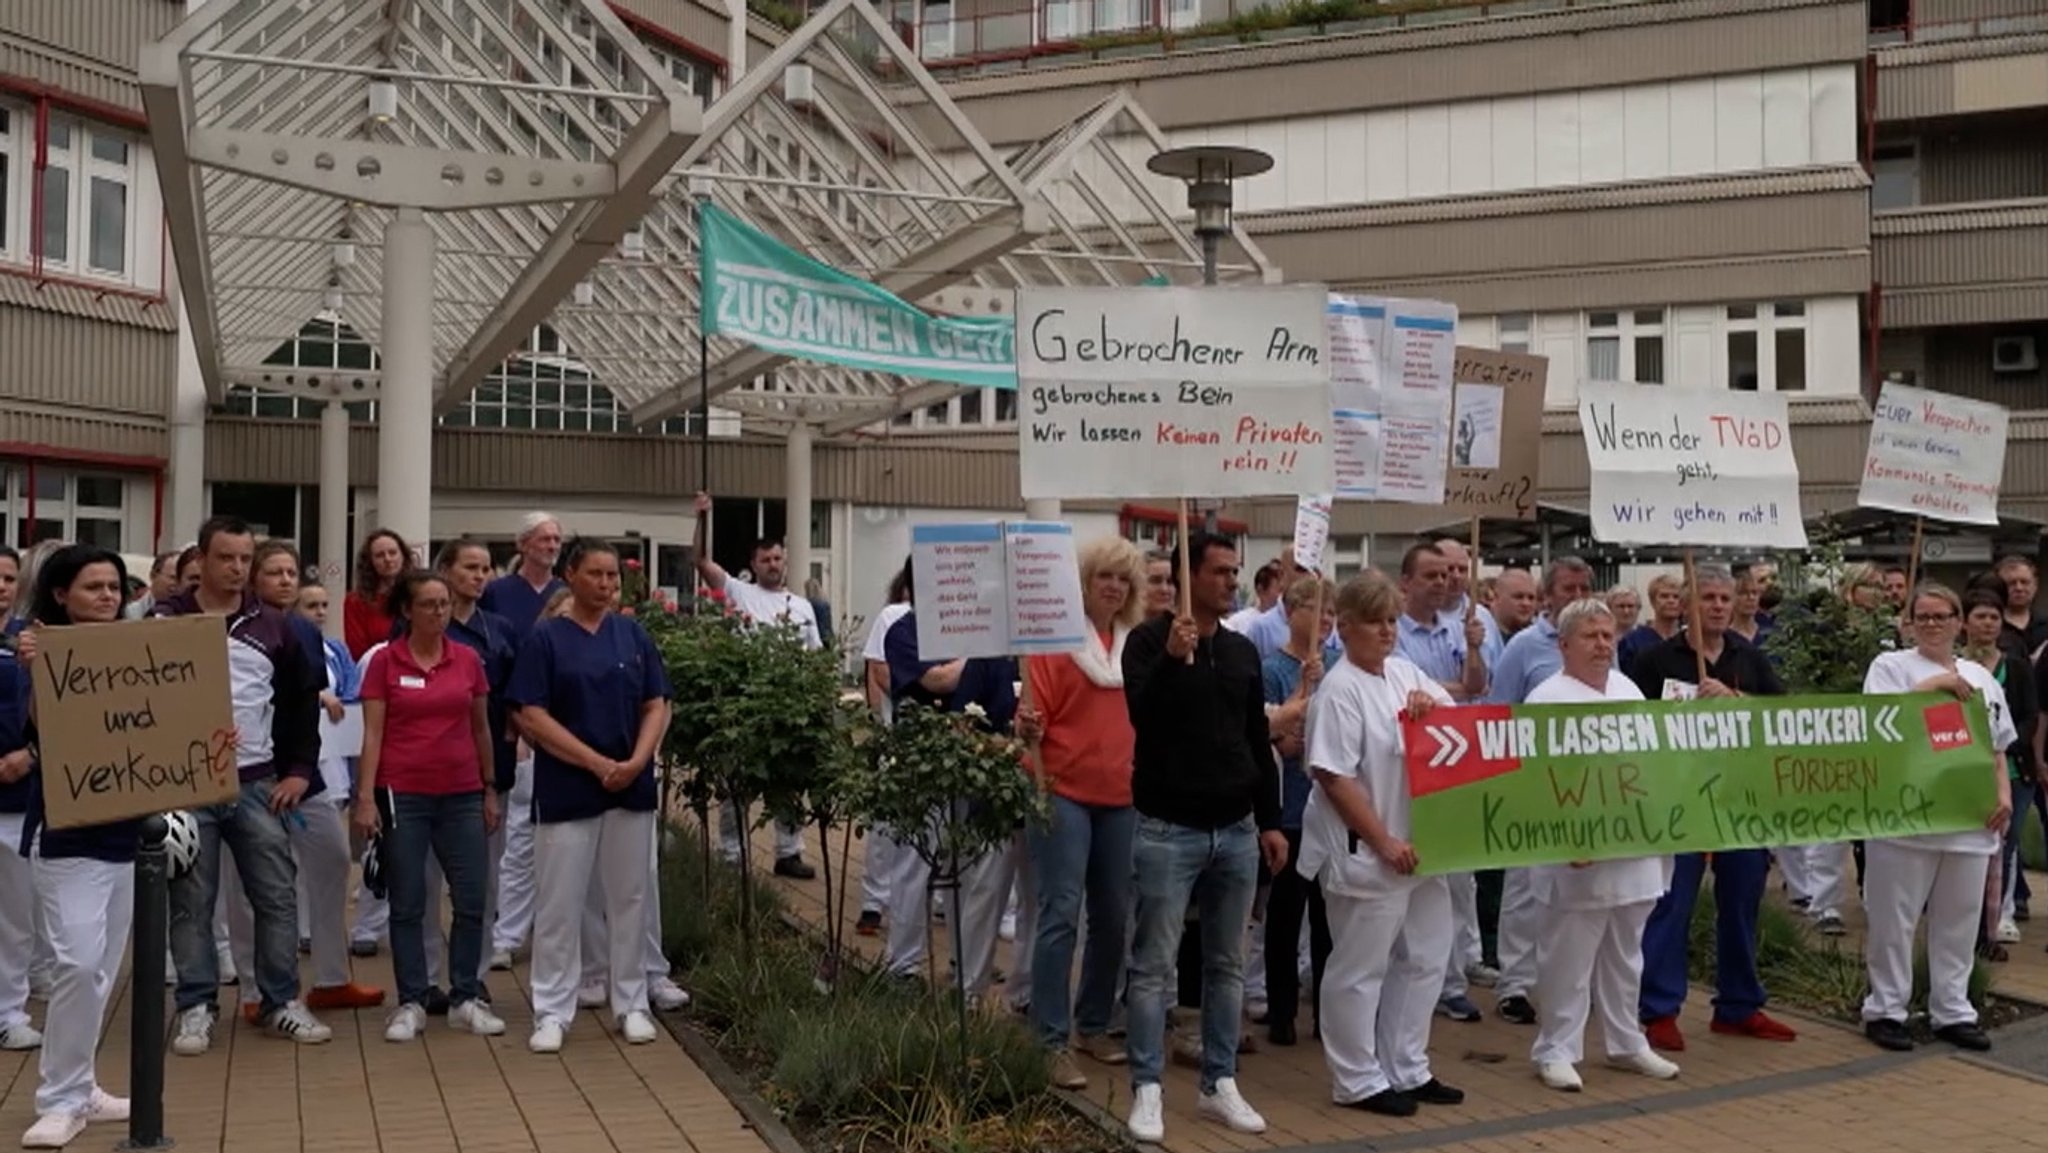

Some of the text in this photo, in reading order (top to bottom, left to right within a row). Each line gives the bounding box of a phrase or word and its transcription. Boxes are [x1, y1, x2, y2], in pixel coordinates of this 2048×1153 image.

[716, 274, 1014, 362] ZUSAMMEN GEH
[1032, 309, 1244, 365] Gebrochener
[1032, 380, 1233, 414] gebrochenes Bein
[1032, 422, 1066, 442] Wir
[1081, 419, 1142, 442] lassen
[1236, 416, 1323, 444] Privaten
[1590, 403, 1663, 450] Wenn
[1669, 414, 1700, 450] der
[1223, 450, 1268, 472] rein
[1867, 456, 1936, 486] Kommunale
[1674, 502, 1726, 530] gehen
[44, 643, 196, 702] Verraten
[104, 697, 157, 734] und
[1476, 706, 1868, 760] WIR LASSEN NICHT LOCKER!
[1548, 755, 1878, 808] WIR FORDERN
[1483, 773, 1935, 855] Kommunale Trägerschaft
